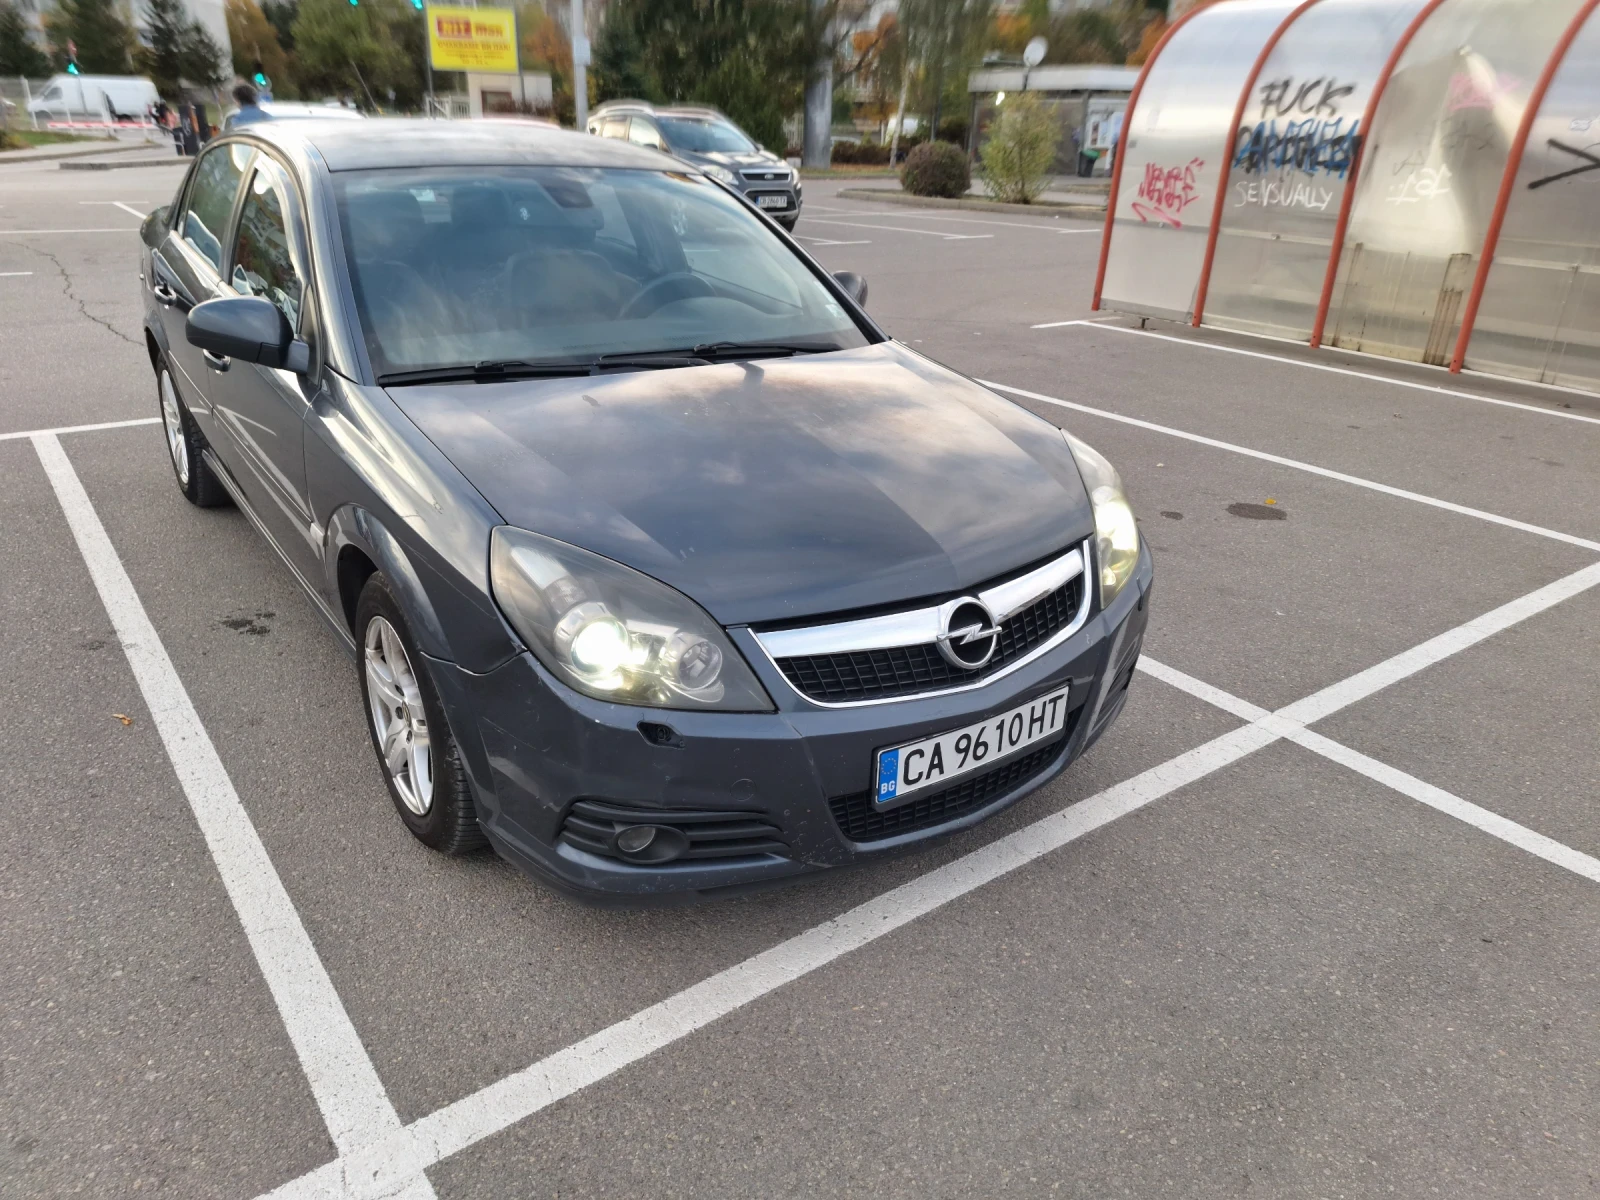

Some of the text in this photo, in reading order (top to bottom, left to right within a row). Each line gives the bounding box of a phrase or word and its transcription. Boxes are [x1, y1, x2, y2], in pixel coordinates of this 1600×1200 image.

[1260, 77, 1355, 118] FUCK
[1234, 179, 1333, 211] SENSUALLY
[903, 694, 1065, 786] CA 9610 HT
[880, 780, 896, 795] BG
